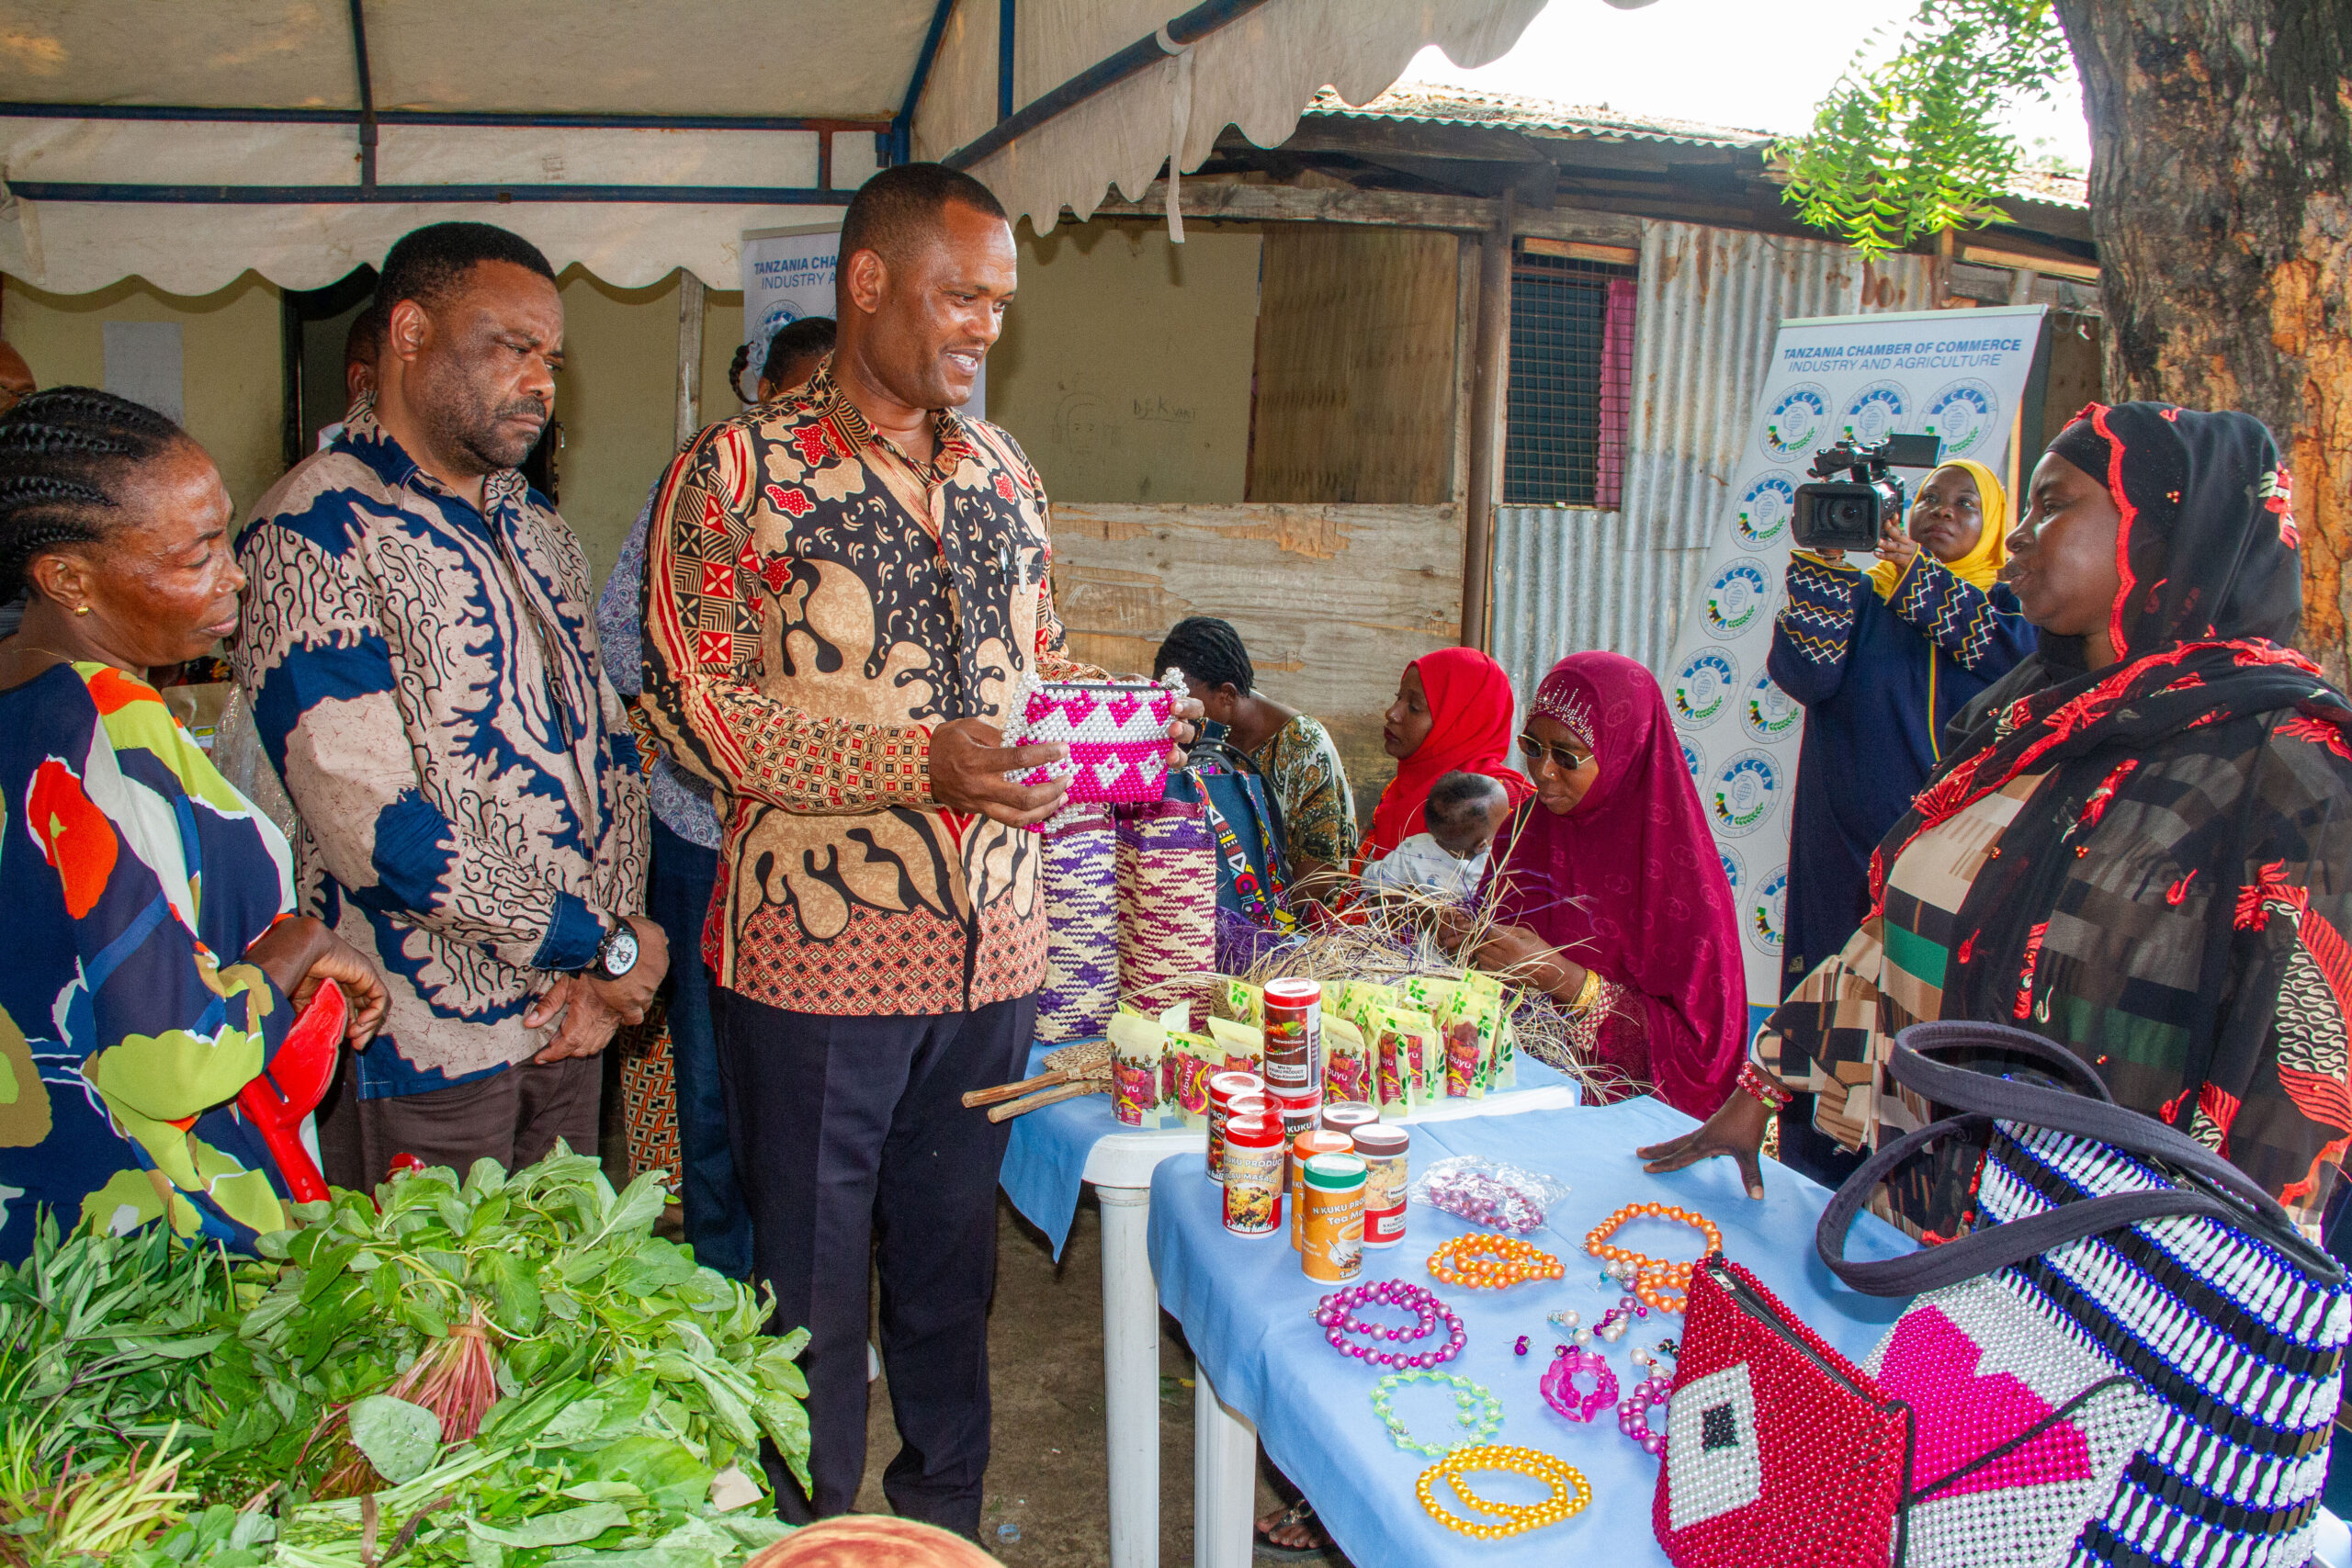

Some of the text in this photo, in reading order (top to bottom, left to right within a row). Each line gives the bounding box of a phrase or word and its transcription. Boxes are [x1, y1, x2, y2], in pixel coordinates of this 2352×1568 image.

[754, 257, 808, 275] TANZANIA
[761, 272, 826, 290] INDUSTRY
[1783, 338, 2022, 359] TANZANIA CHAMBER OF COMMERCE
[1788, 354, 2002, 372] INDUSTRY AND AGRICULTURE
[1730, 761, 1772, 786] TCCIA
[1182, 1059, 1193, 1097] Ubuyu
[1287, 1122, 1312, 1134] KUKU
[1243, 1173, 1278, 1184] MASALA
[1321, 1202, 1348, 1214] KUKU
[1327, 1216, 1349, 1226] Tea
